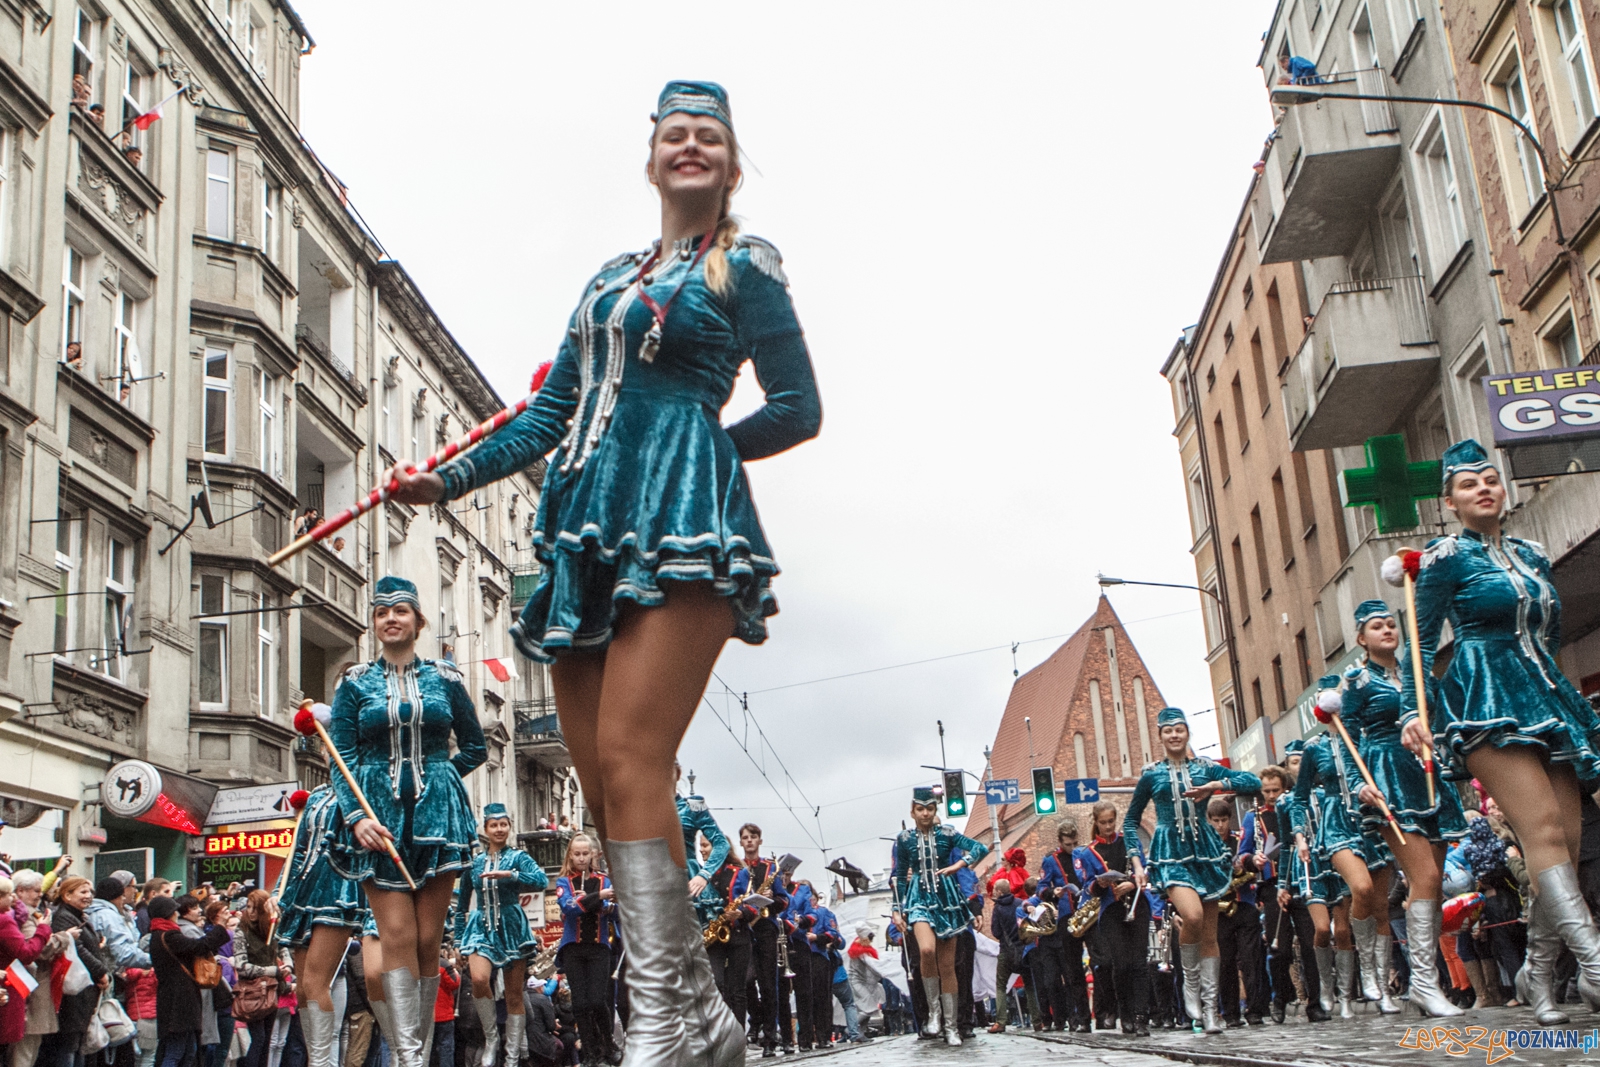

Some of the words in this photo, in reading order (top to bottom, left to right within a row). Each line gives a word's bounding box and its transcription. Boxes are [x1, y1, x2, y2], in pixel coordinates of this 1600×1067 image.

[1489, 370, 1600, 397] TELEF
[202, 856, 256, 874] SERWIS
[215, 874, 242, 884] LAPTOPY
